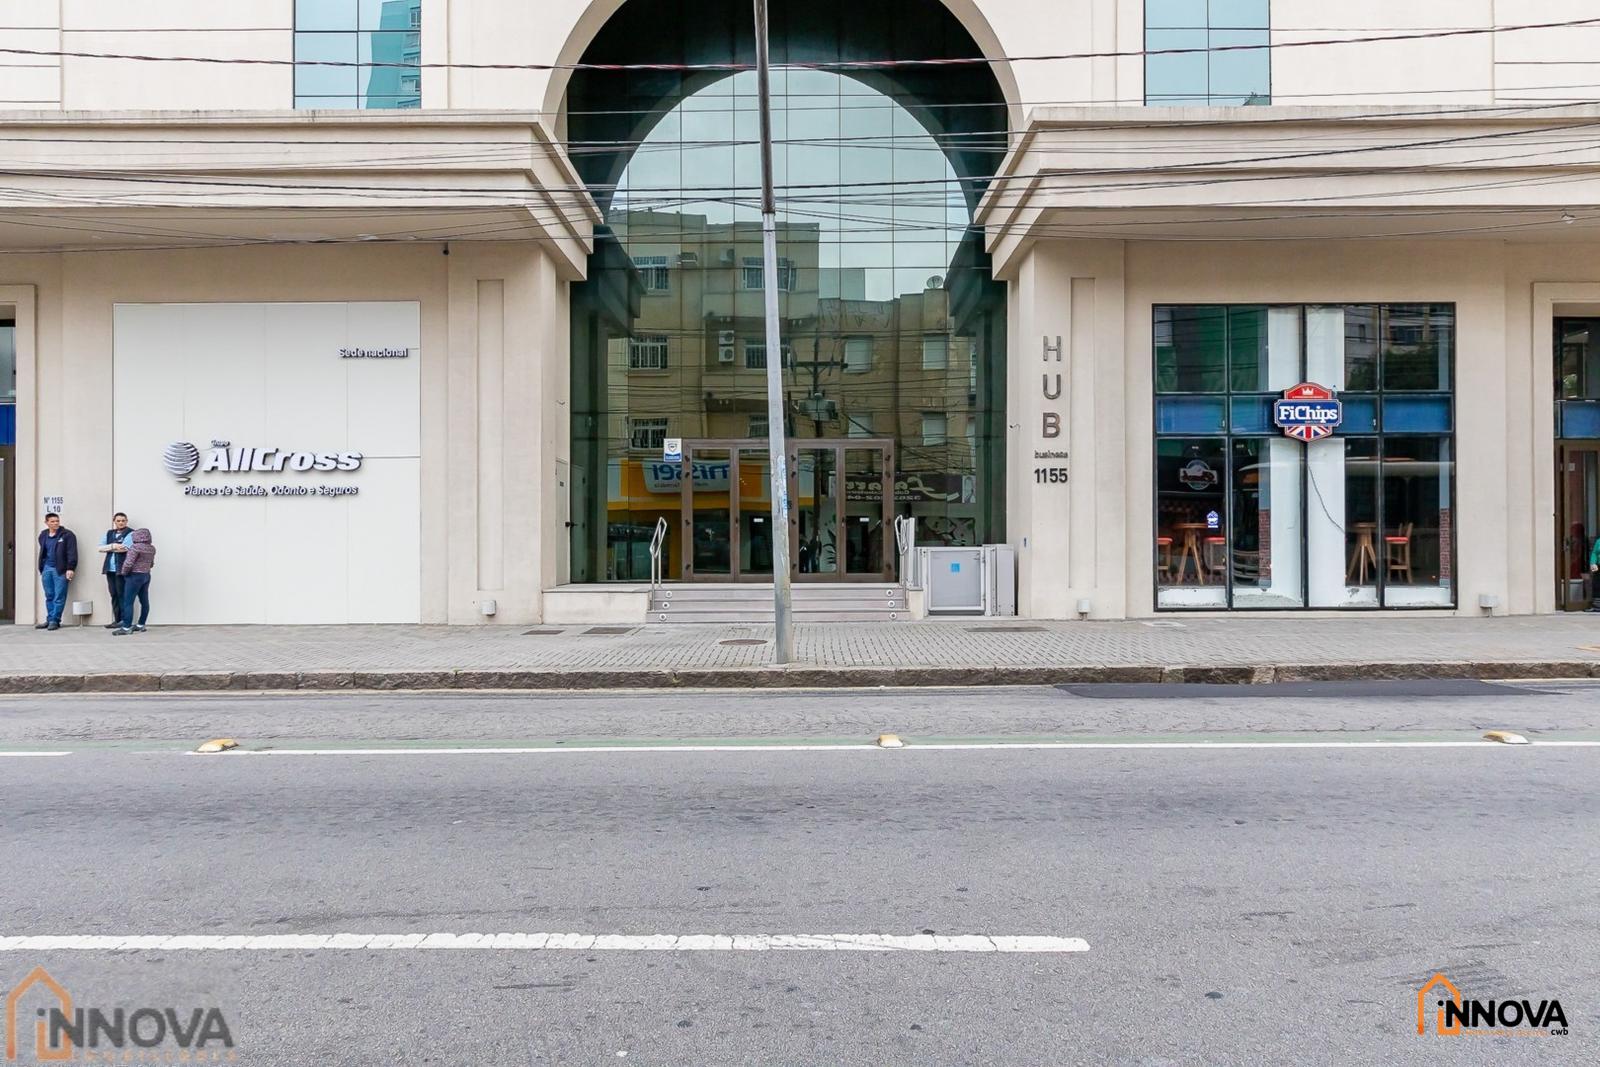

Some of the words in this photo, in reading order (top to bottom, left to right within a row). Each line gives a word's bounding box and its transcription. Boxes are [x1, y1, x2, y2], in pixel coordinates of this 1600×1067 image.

[338, 348, 365, 358] Sede
[366, 348, 408, 358] nacional
[1042, 335, 1062, 438] HUB
[1279, 405, 1338, 423] FiChips
[202, 447, 364, 473] AllCross
[1034, 450, 1068, 459] business
[1034, 468, 1068, 483] 1155
[184, 486, 217, 496] Planos
[219, 486, 232, 496] de
[271, 486, 306, 496] Odonto
[318, 486, 359, 498] Seguros
[51, 496, 64, 504] 1155
[53, 505, 61, 513] 10
